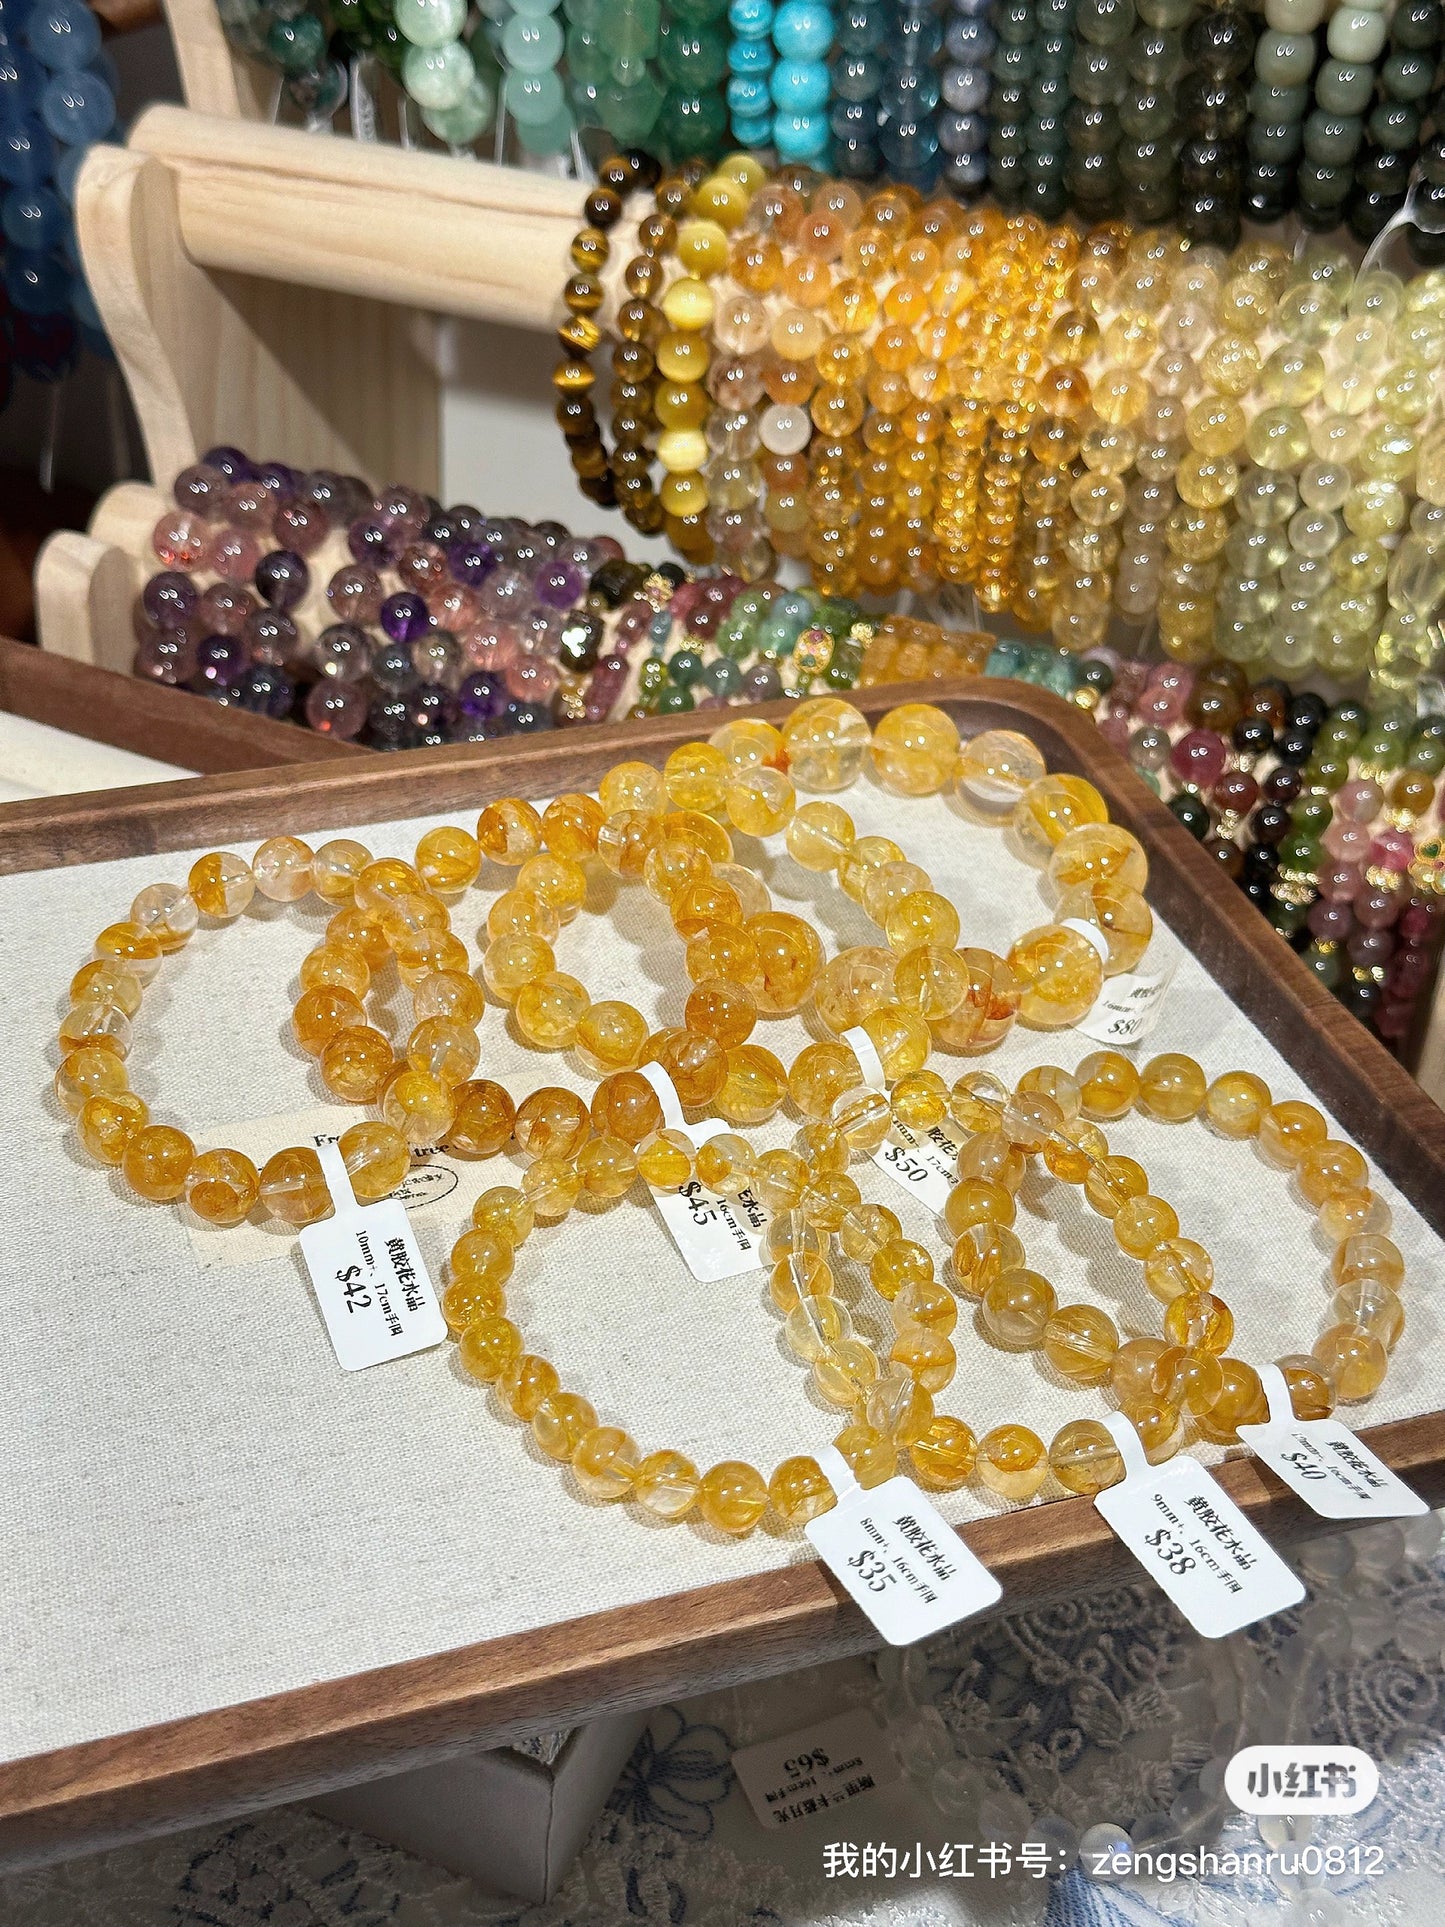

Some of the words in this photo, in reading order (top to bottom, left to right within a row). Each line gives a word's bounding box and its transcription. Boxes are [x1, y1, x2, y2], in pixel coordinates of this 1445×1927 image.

[413, 1144, 450, 1158] tree
[884, 1146, 929, 1182] $50
[678, 1181, 718, 1226] $45
[334, 1264, 372, 1314] $42
[384, 1236, 426, 1312] 黄胶花水晶
[1280, 1452, 1327, 1480] $40
[892, 1514, 957, 1581] 黄胶花水晶
[1144, 1528, 1197, 1575] $38
[1184, 1494, 1258, 1571] 黄胶花水晶
[846, 1550, 898, 1592] $35
[783, 1747, 830, 1779] $65
